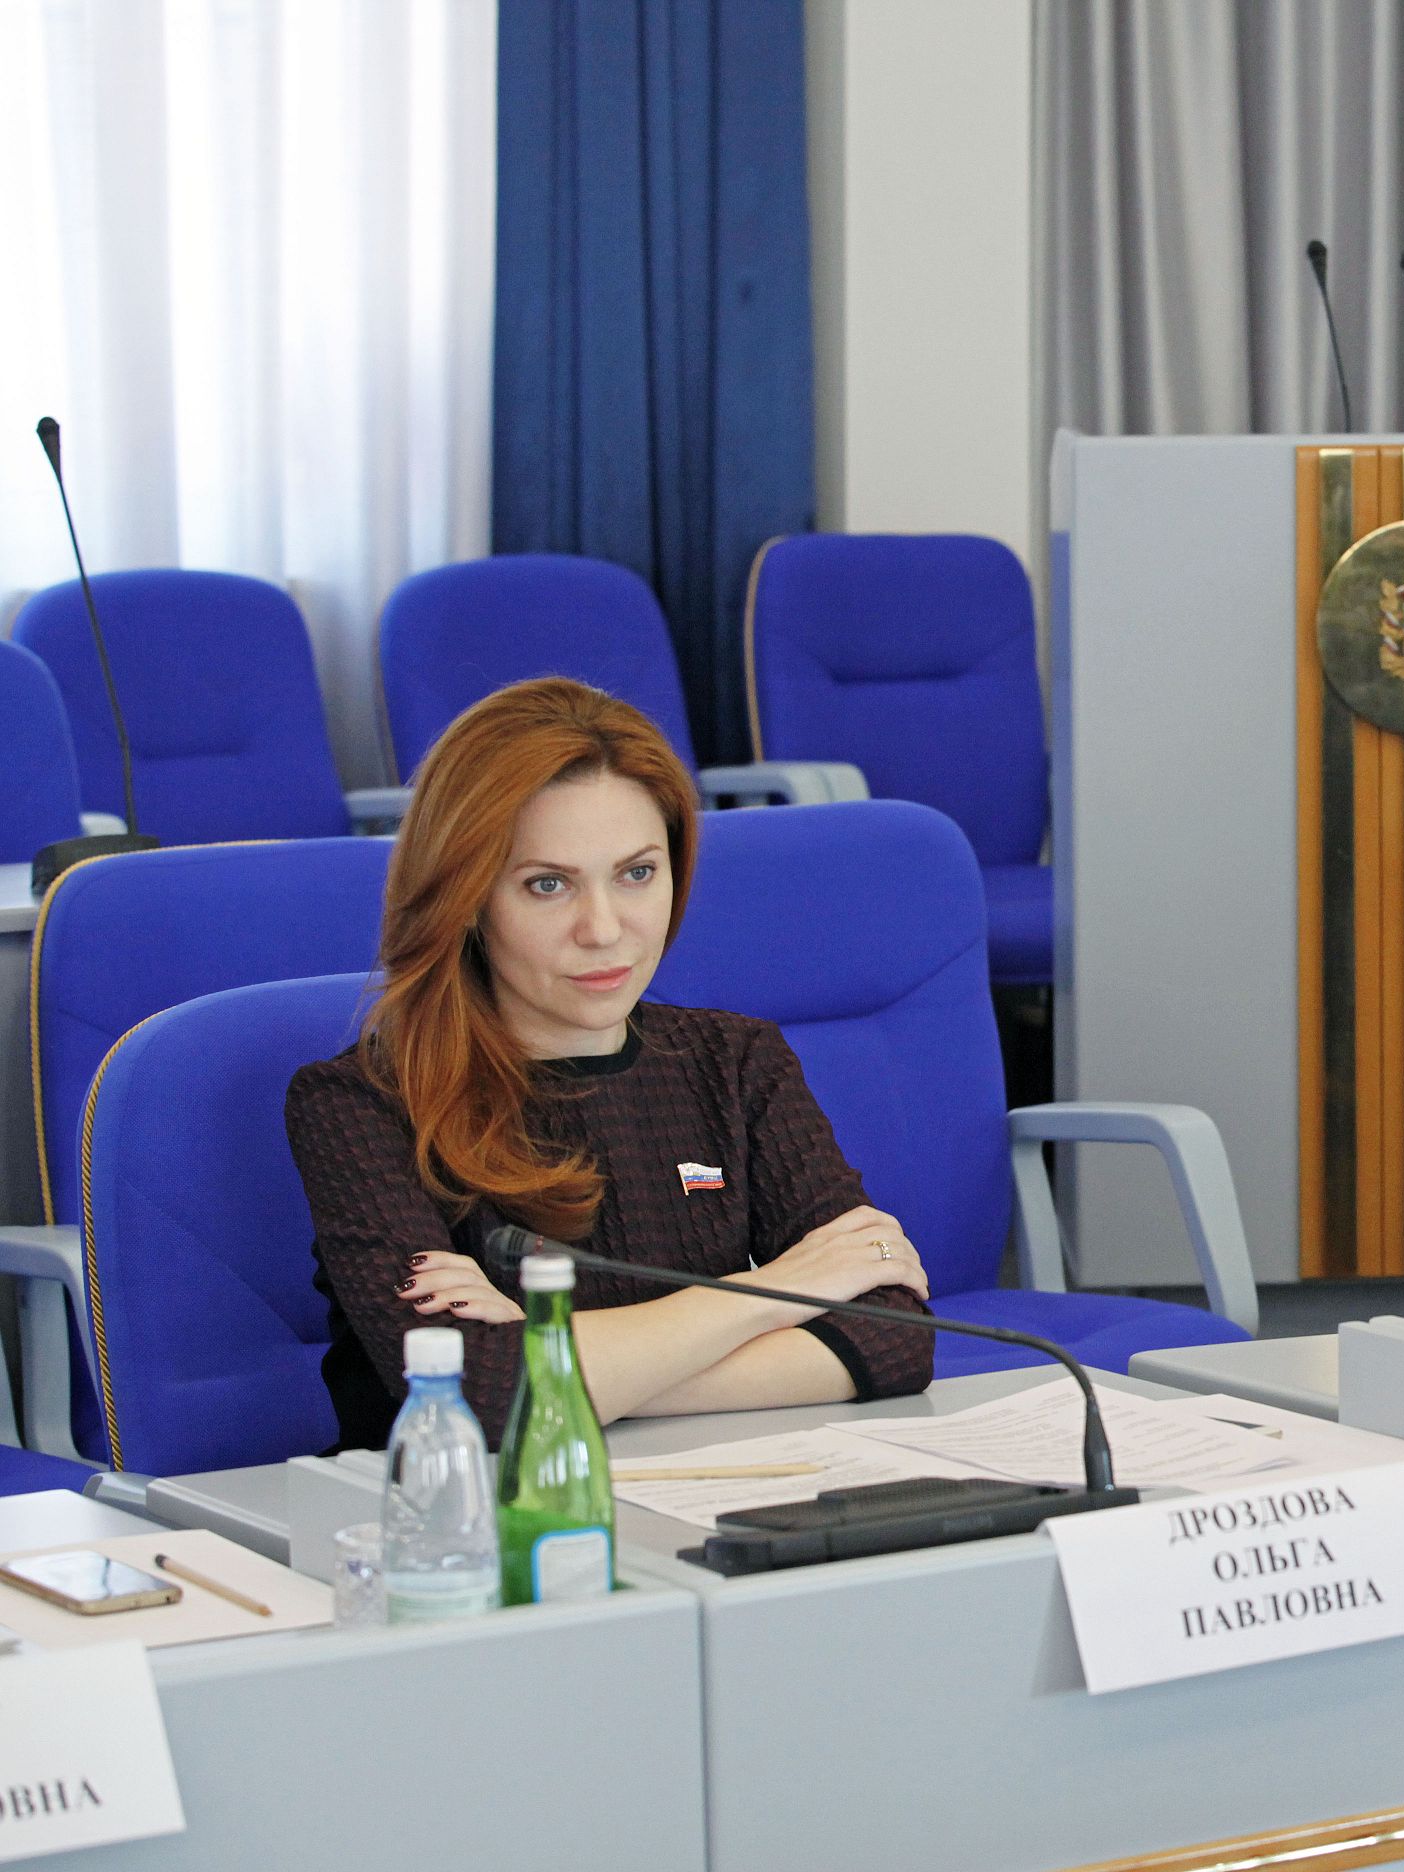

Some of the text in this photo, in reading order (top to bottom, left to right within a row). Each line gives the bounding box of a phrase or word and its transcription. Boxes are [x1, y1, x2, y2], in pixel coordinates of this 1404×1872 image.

[1169, 1486, 1356, 1545] ДРОЗДОВА
[1212, 1539, 1336, 1583] ОЛЬГА
[1182, 1578, 1384, 1638] ПАВЛОВНА
[0, 1779, 101, 1819] ВНА
